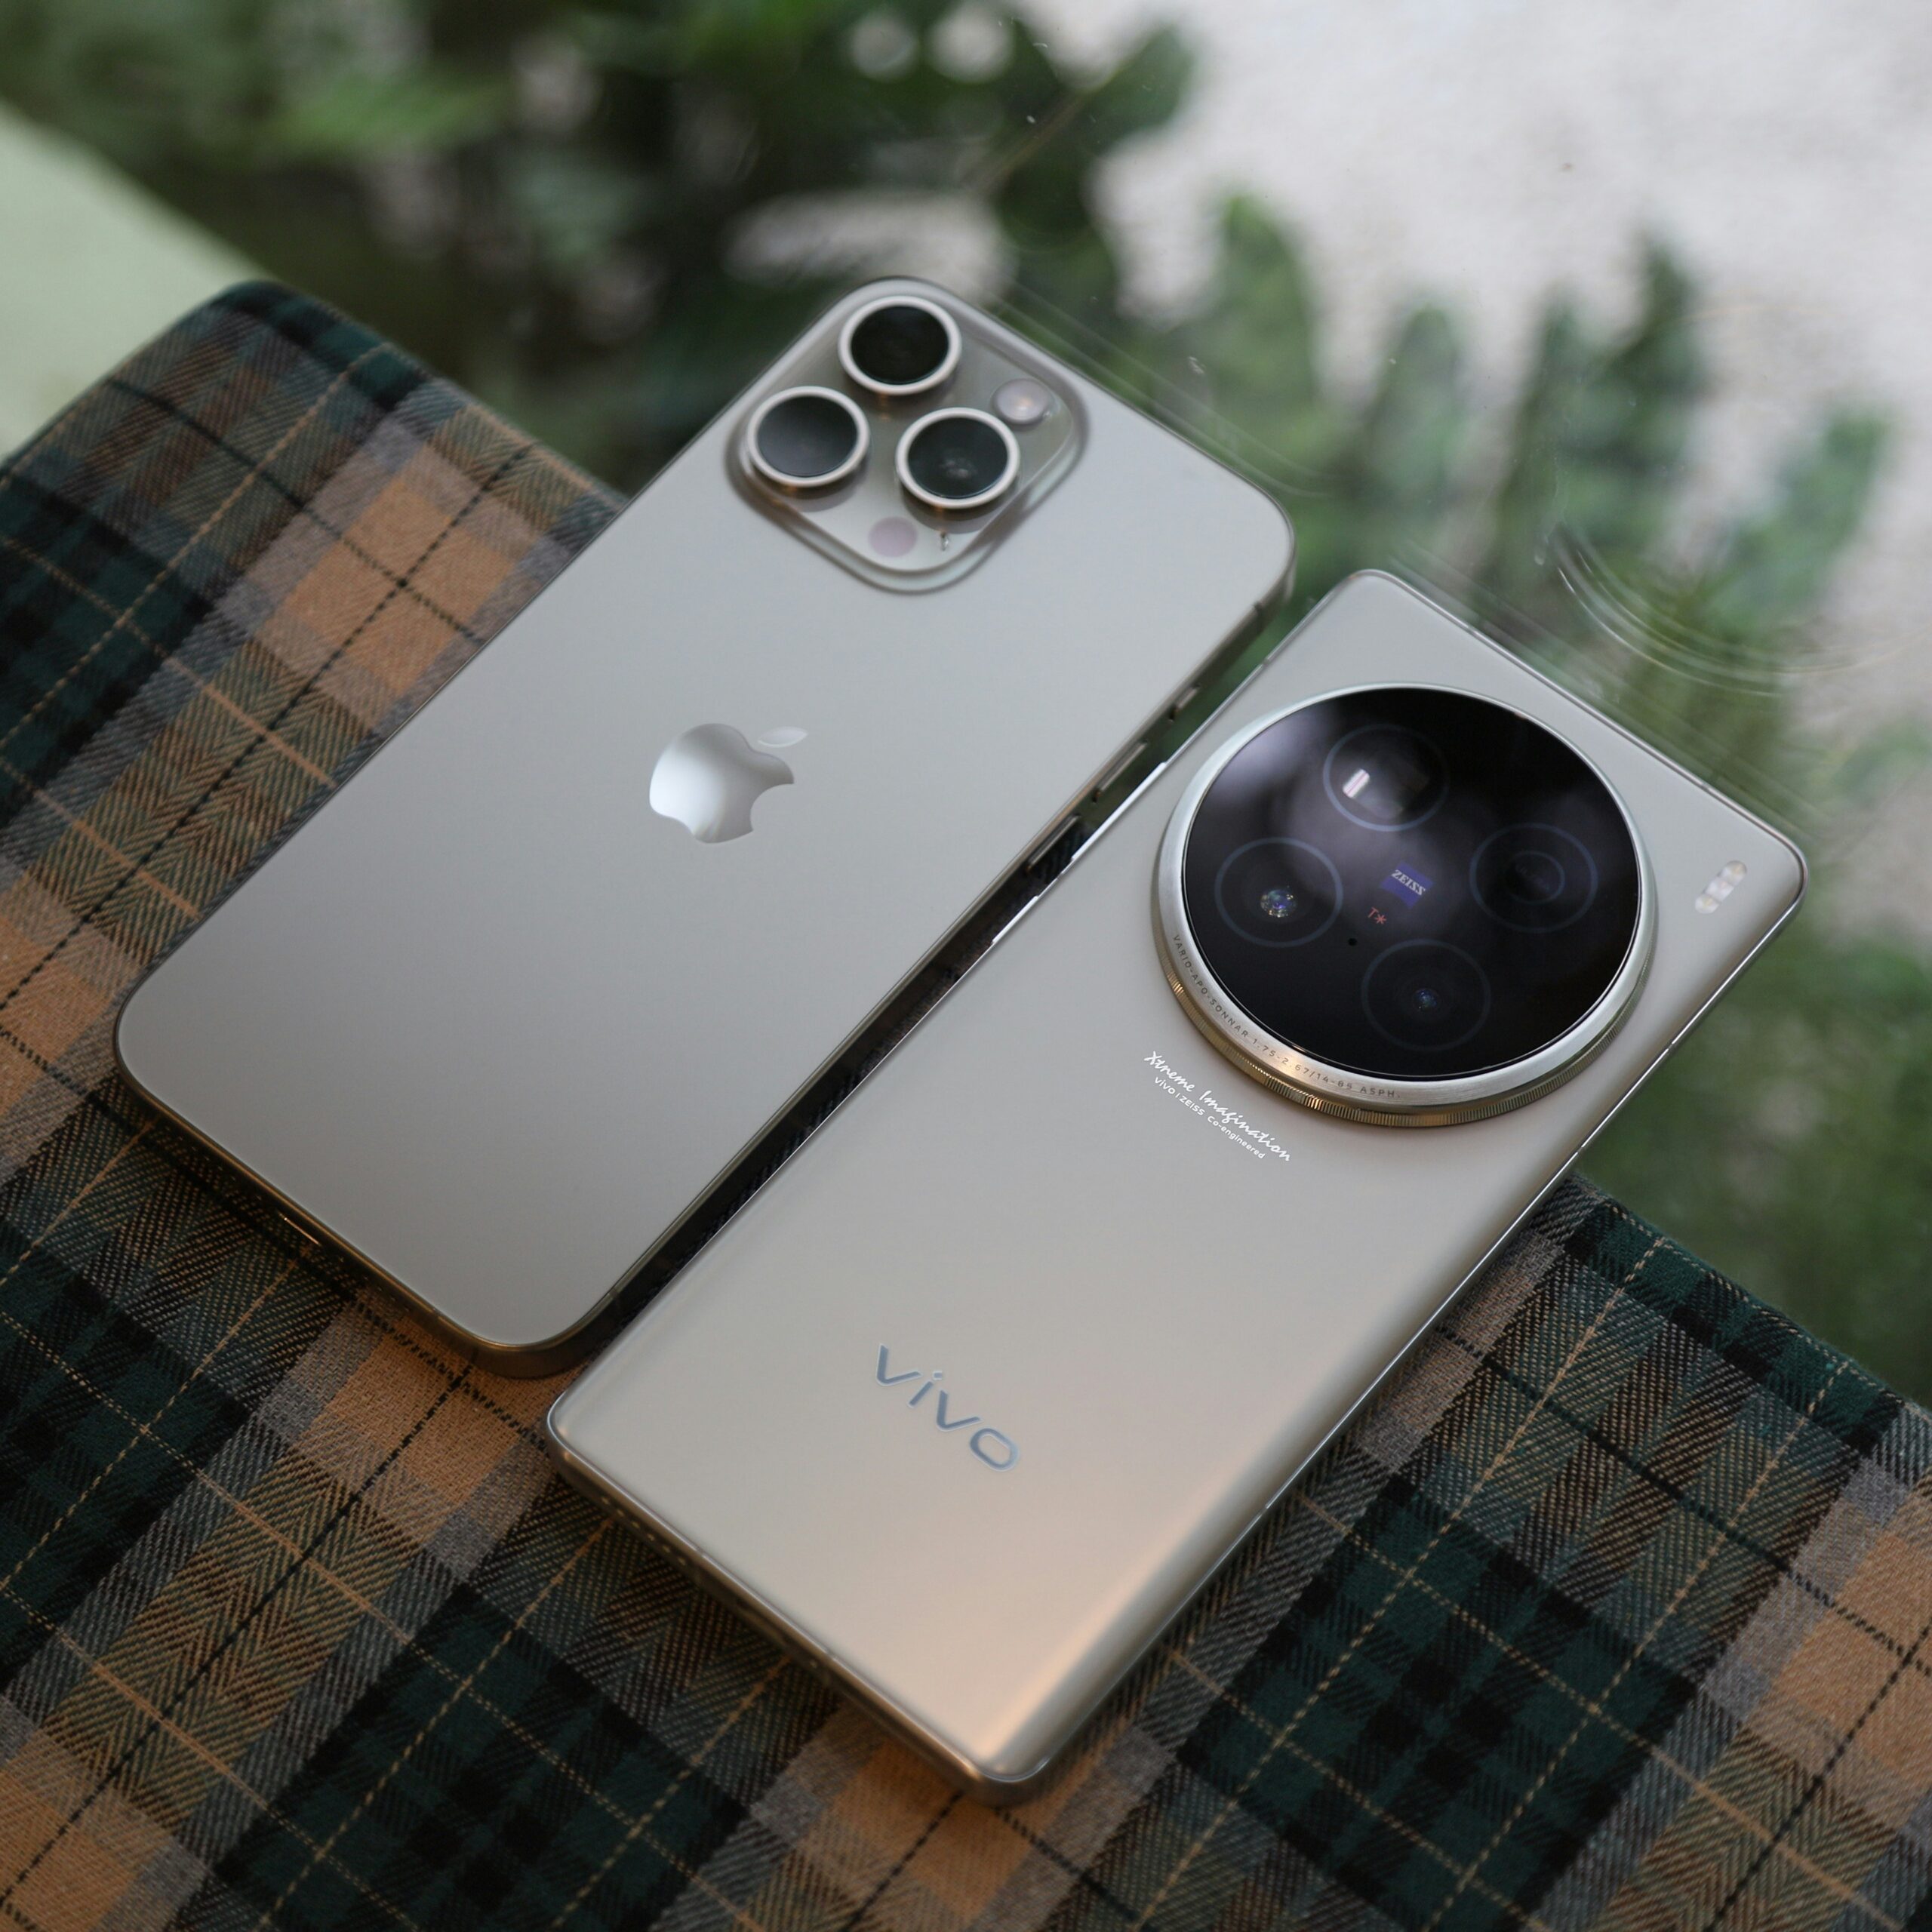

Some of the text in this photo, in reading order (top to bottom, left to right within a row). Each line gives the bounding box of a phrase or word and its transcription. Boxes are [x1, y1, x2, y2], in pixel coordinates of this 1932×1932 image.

[1391, 869, 1426, 896] ZEISS
[1173, 934, 1248, 1038] VARIO-APO-SONNAR
[1360, 1086, 1401, 1098] ASPH.
[1143, 1051, 1290, 1161] Xtreme Imagination
[1179, 1094, 1205, 1116] ZEISS
[1208, 1115, 1266, 1159] Co-engineered
[876, 1343, 1020, 1472] vivo
